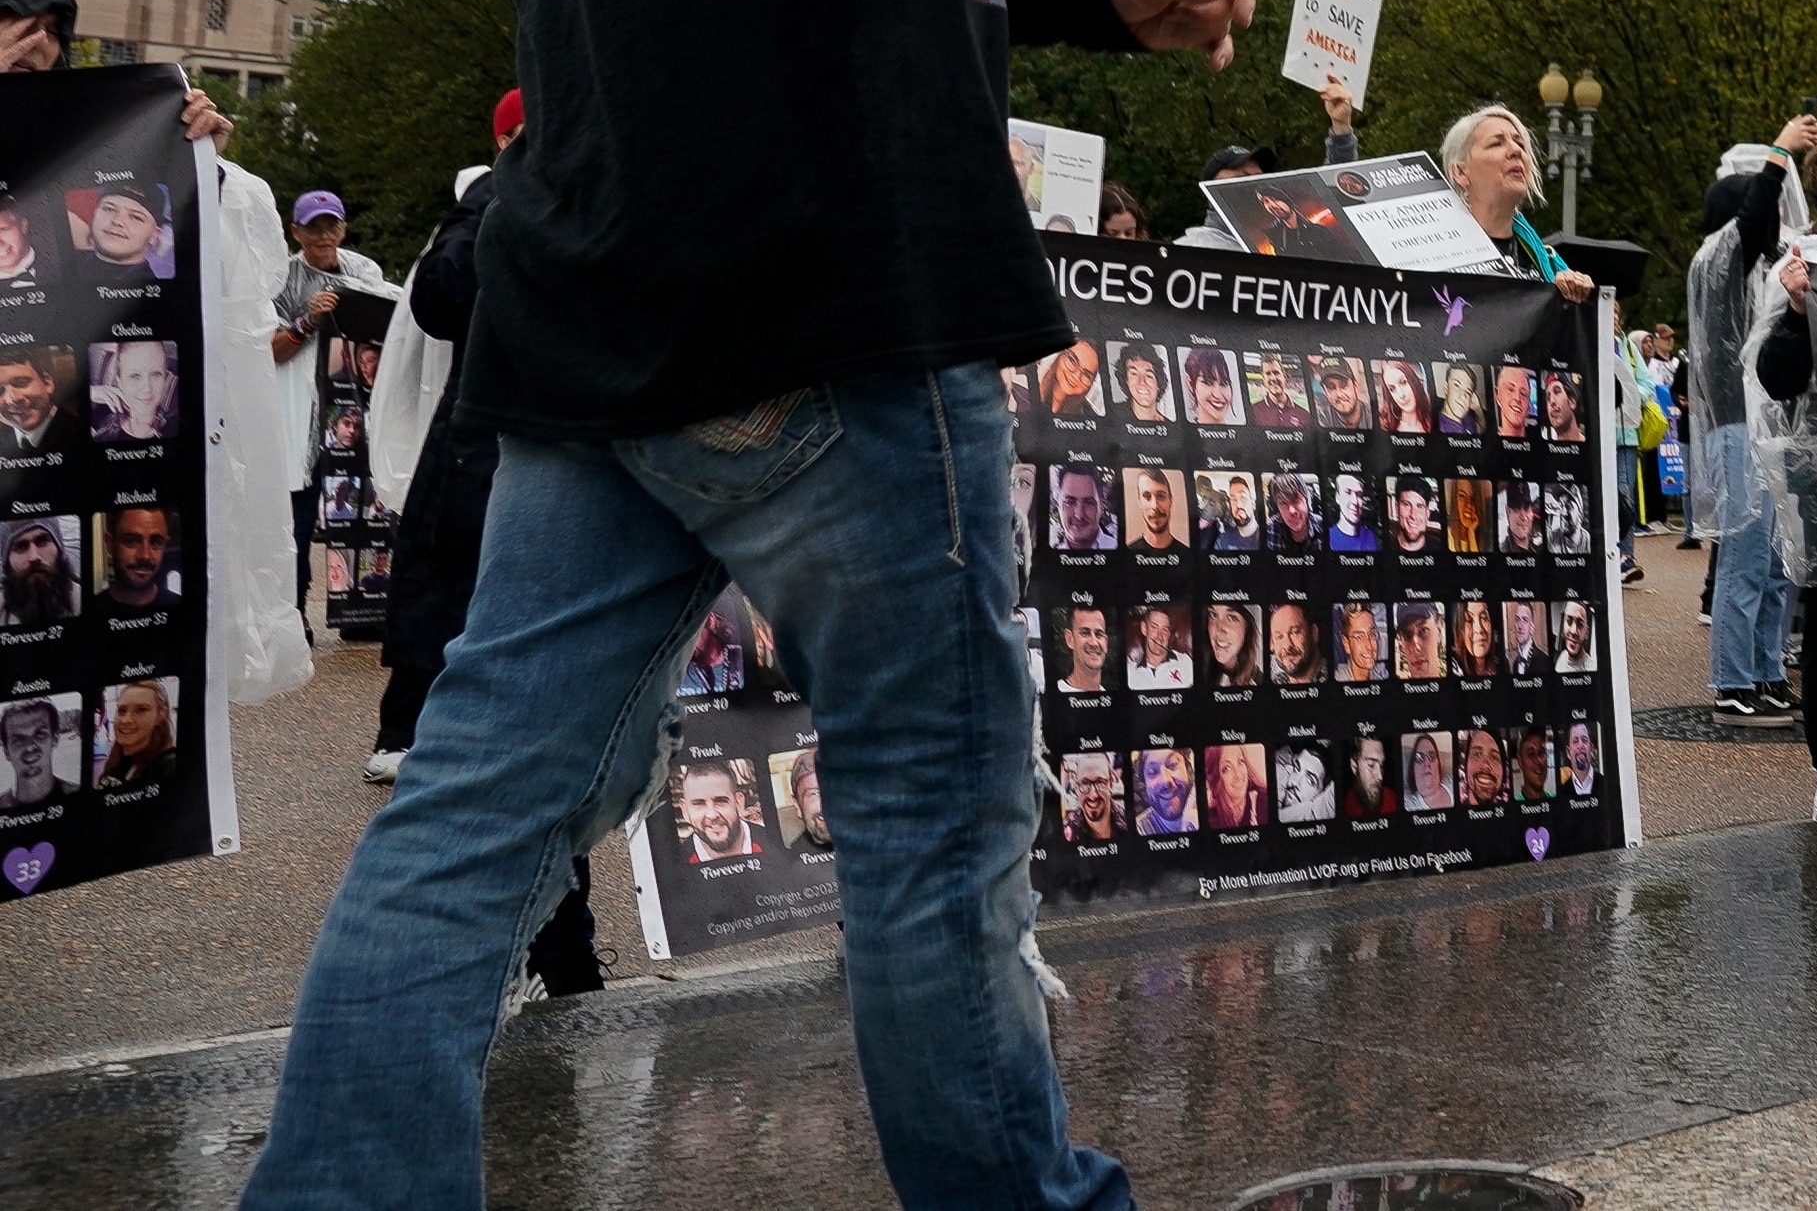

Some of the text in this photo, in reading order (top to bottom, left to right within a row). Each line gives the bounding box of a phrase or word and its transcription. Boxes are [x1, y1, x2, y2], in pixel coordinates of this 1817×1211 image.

[1328, 5, 1364, 37] SAVE
[94, 170, 135, 185] Jason
[1391, 233, 1444, 250] FOREVER
[26, 291, 46, 304] 22
[97, 285, 161, 299] Forever 22
[1047, 257, 1421, 328] ICES OF FENTANYL
[105, 446, 164, 461] Forever 24
[114, 489, 157, 505] Michael
[11, 500, 52, 514] Steven
[108, 616, 152, 631] Forever
[0, 626, 64, 646] Forever 27
[120, 662, 156, 678] Amber
[11, 679, 52, 694] Austin
[794, 729, 819, 747] Just
[104, 790, 145, 806] Forever
[0, 805, 64, 829] Forever 29
[15, 858, 42, 883] 33
[700, 858, 762, 880] Forever 42
[1199, 848, 1473, 892] For More Information LVOF.org or Find Us On Facebook
[755, 891, 802, 907] Copyright
[707, 897, 842, 936] Copying and/or Reproduc
